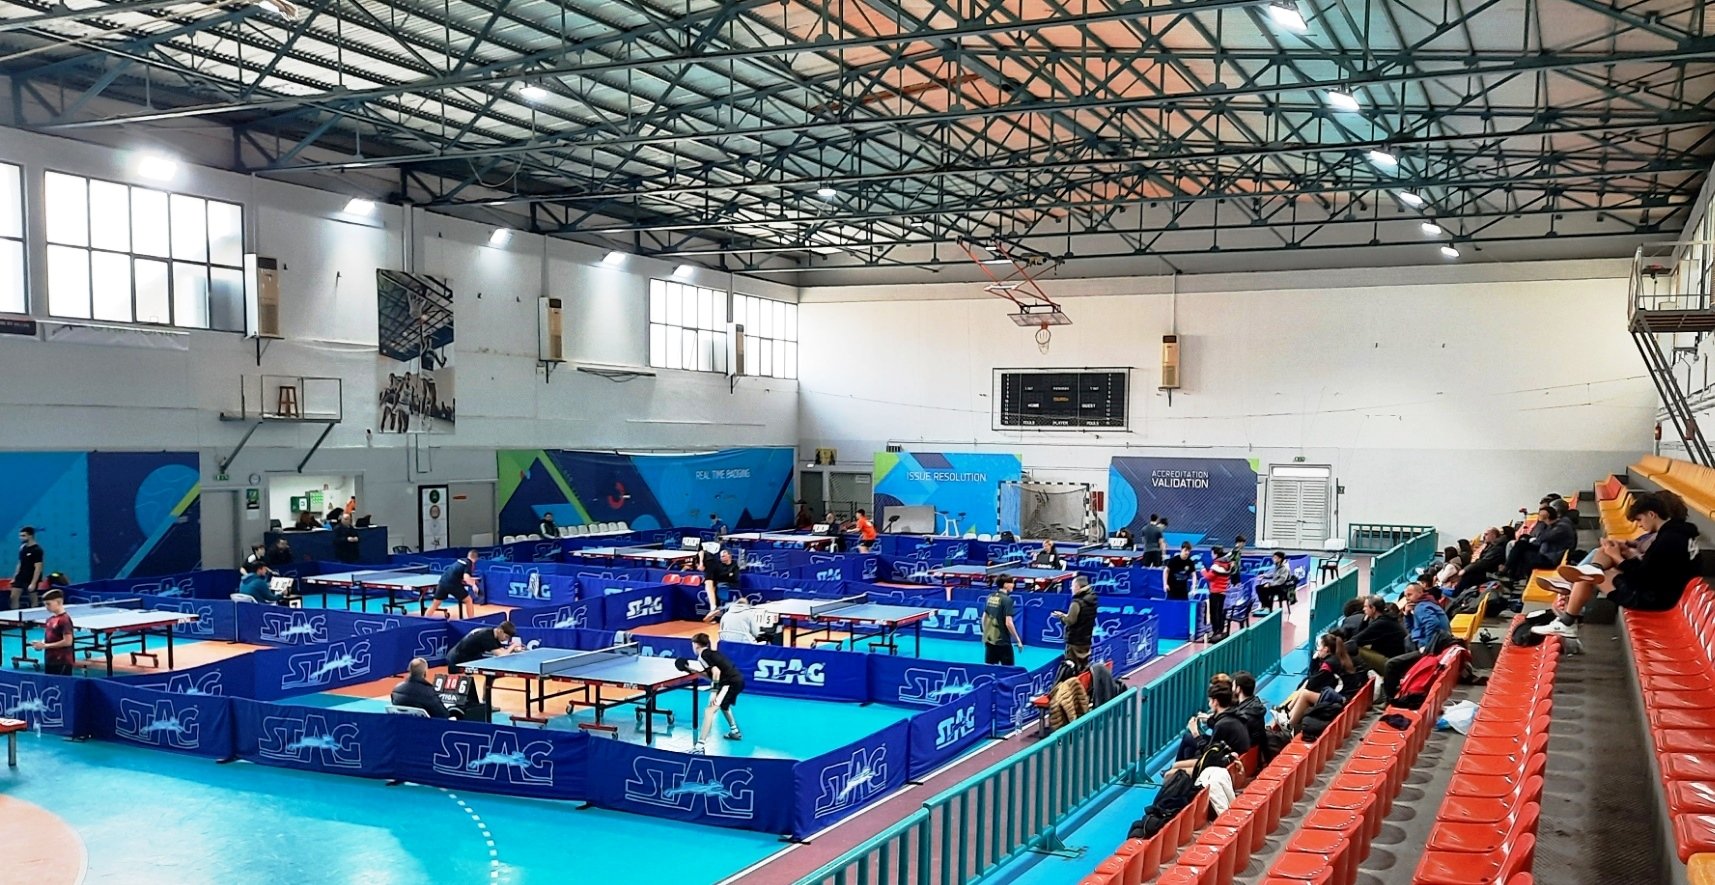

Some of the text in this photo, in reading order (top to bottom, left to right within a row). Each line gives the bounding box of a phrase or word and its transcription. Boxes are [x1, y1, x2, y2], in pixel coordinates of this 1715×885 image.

[906, 472, 987, 482] ISSUE RESOLUTION
[1151, 470, 1209, 478] ACCREDITATION
[1151, 478, 1209, 489] VALIDATION
[626, 595, 663, 620] STAG
[261, 611, 328, 646] STAG
[281, 638, 372, 690] STAG
[753, 658, 826, 687] STAG
[434, 678, 468, 694] 9 10 6
[116, 698, 200, 749] STAG
[259, 715, 362, 769] STAG
[935, 705, 976, 751] STAG
[433, 731, 554, 787] STAG
[625, 757, 754, 819] STAG
[815, 745, 888, 819] STAG
